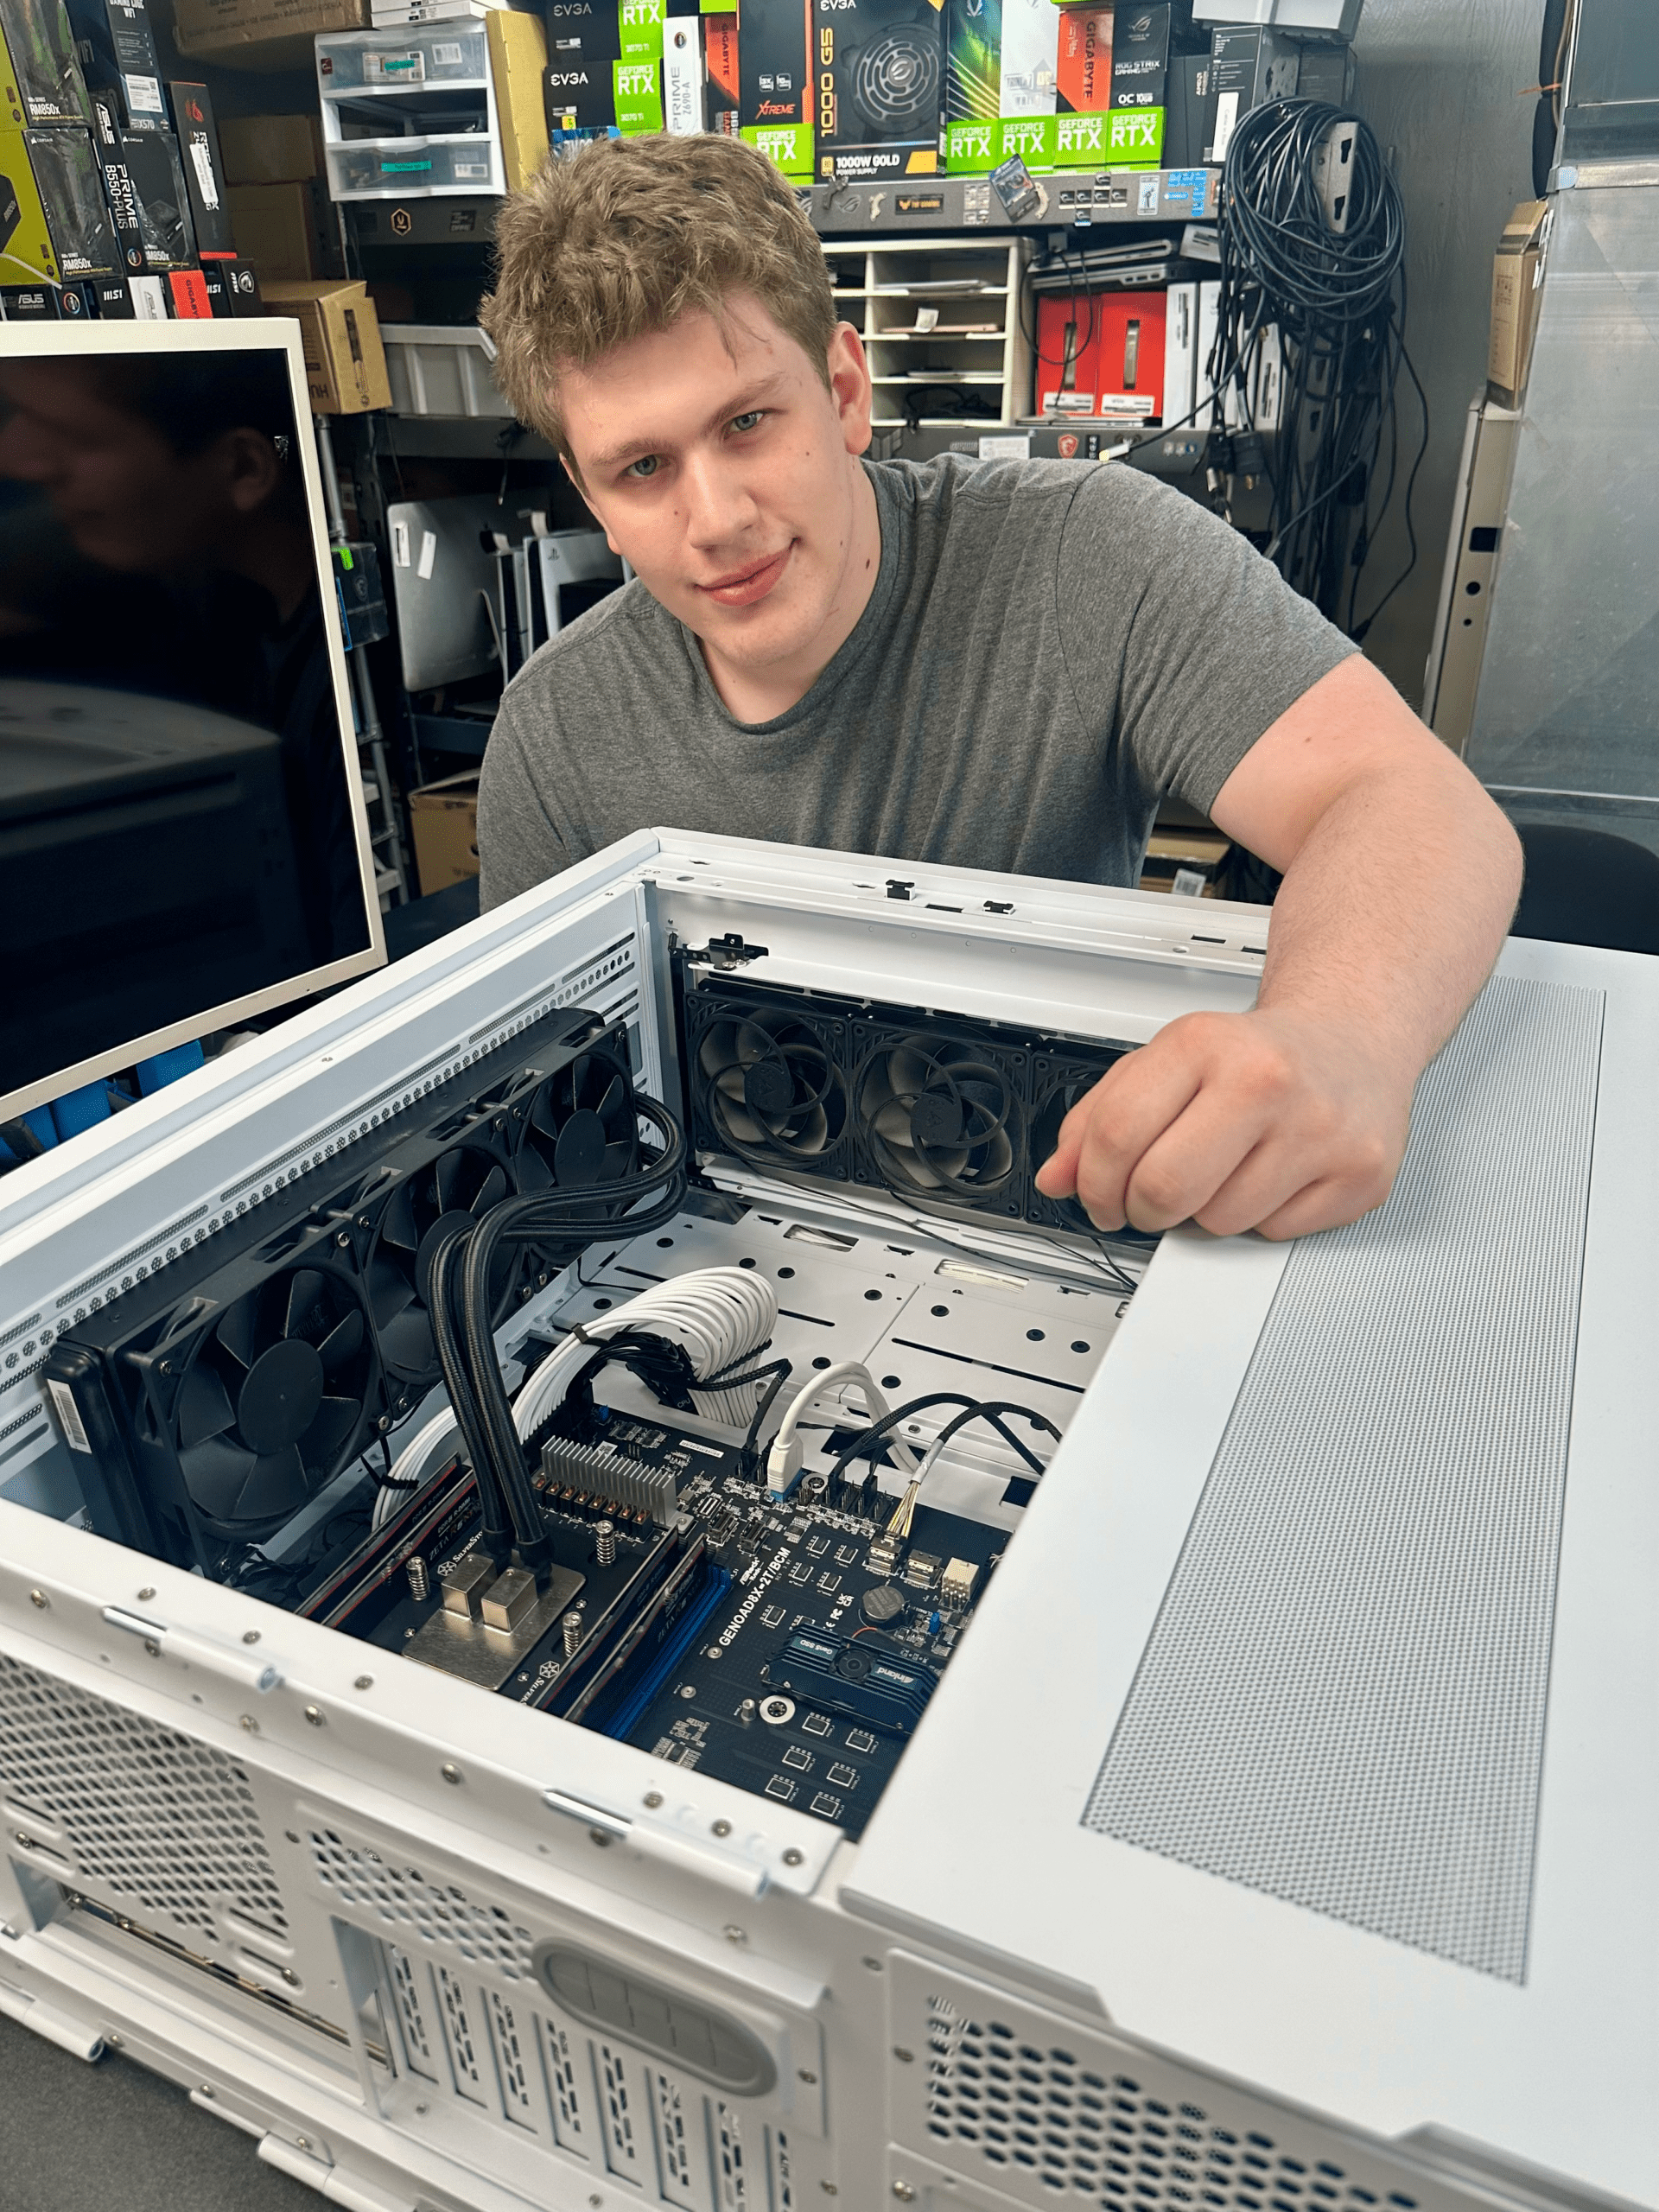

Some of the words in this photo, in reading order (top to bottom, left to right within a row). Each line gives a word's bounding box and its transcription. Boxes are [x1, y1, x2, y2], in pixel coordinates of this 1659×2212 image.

[553, 3, 592, 16] EVGA
[820, 0, 856, 11] EVGA
[623, 3, 661, 26] RTX
[721, 23, 731, 76] GIGABYTE
[820, 27, 834, 66] G5
[1084, 21, 1096, 103] GIGABYTE
[1135, 60, 1160, 69] STRIX
[618, 64, 654, 76] GEFORCE
[550, 72, 588, 86] EVGA
[618, 74, 654, 96] RTX
[671, 67, 682, 130] PRIME
[820, 72, 834, 137] 1000
[1118, 93, 1135, 105] OC
[29, 103, 60, 115] RM850x
[755, 99, 796, 120] XTREME
[99, 103, 115, 144] ASUS
[1058, 118, 1103, 130] GEFORCE
[1112, 113, 1158, 127] GEFORCE
[757, 130, 797, 141] GEFORCE
[950, 126, 992, 139] GEFORCE
[1003, 122, 1046, 135] GEFORCE
[1058, 129, 1103, 151] RTX
[1110, 124, 1156, 148] RTX
[756, 140, 797, 161] RTX
[950, 137, 991, 158] RTX
[1002, 132, 1045, 155] RTX
[836, 156, 872, 169] 1000W
[872, 154, 900, 167] GOLD
[105, 165, 129, 229] B550-PLUS
[117, 164, 139, 229] PRIME
[62, 257, 92, 270] RM850x
[18, 294, 45, 304] ASUS
[104, 289, 123, 301] MSI
[677, 1397, 691, 1408] CPU
[718, 1546, 791, 1647] GENOAD8X-2T/BCM
[799, 1639, 816, 1649] SSD
[815, 1643, 834, 1655] Gen5
